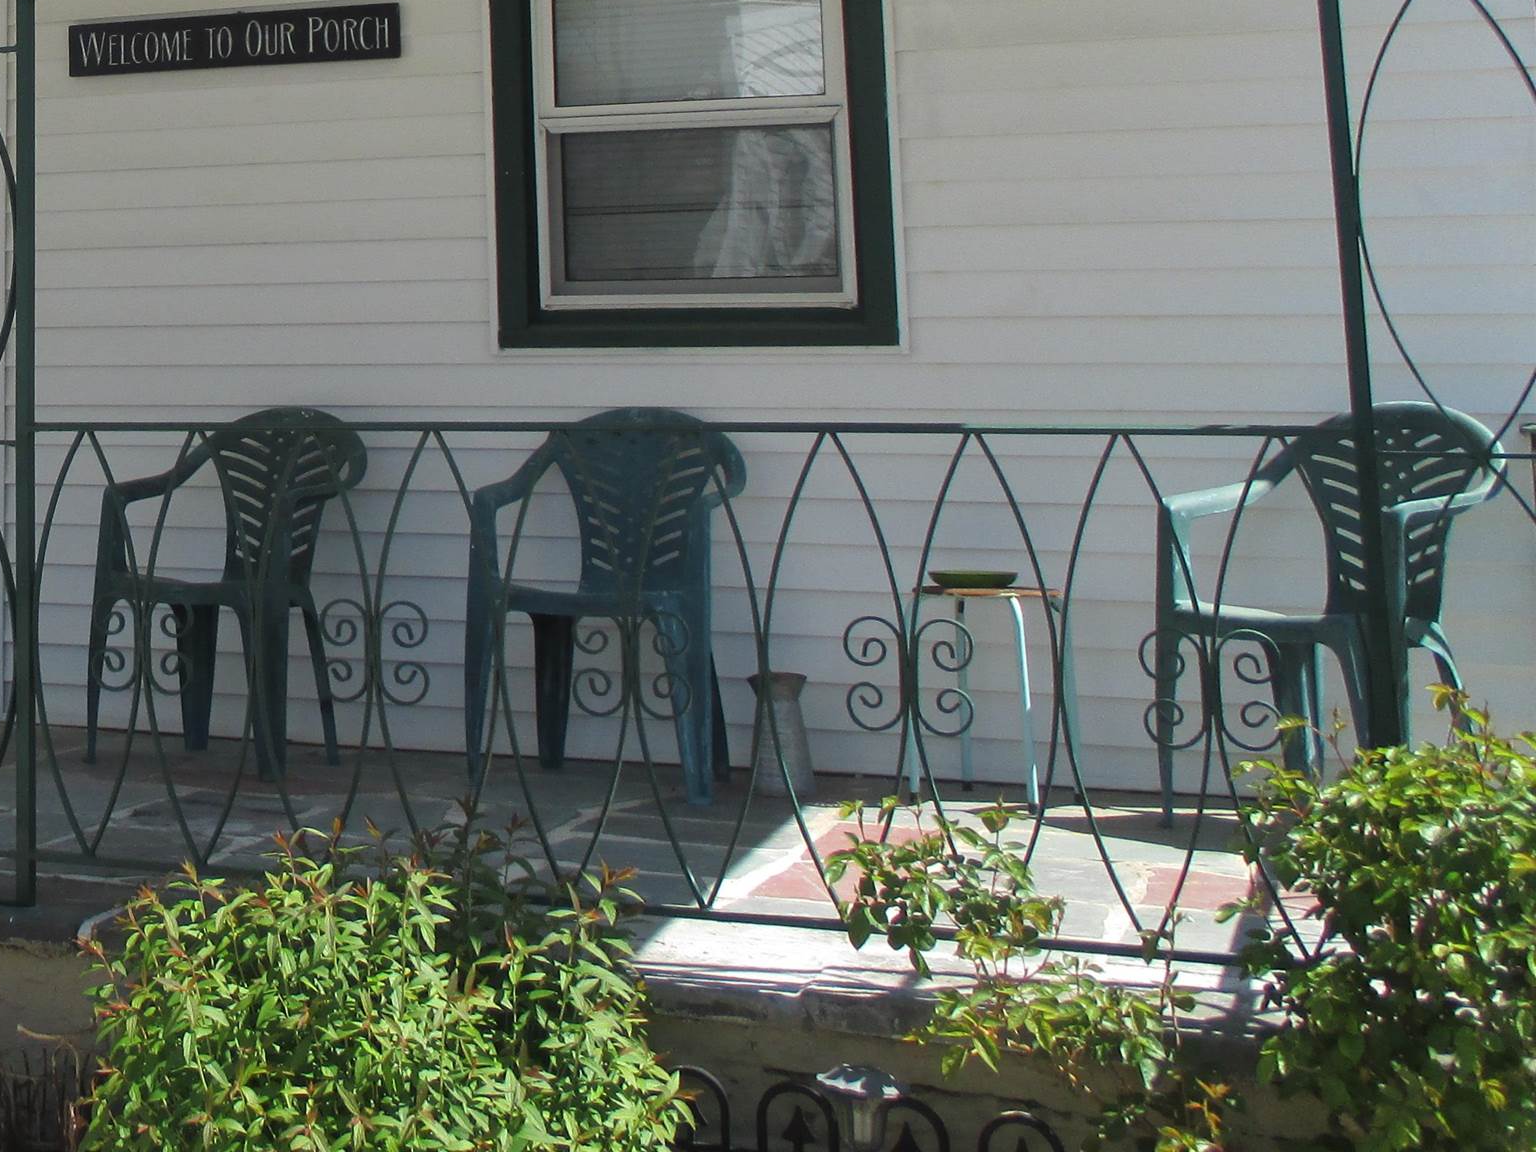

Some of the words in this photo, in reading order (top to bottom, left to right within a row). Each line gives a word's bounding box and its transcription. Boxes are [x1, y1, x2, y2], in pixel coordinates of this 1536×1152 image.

[79, 29, 193, 68] WELCOME
[205, 26, 233, 60] TO
[246, 19, 296, 57] OUR
[308, 16, 390, 54] PORCH
